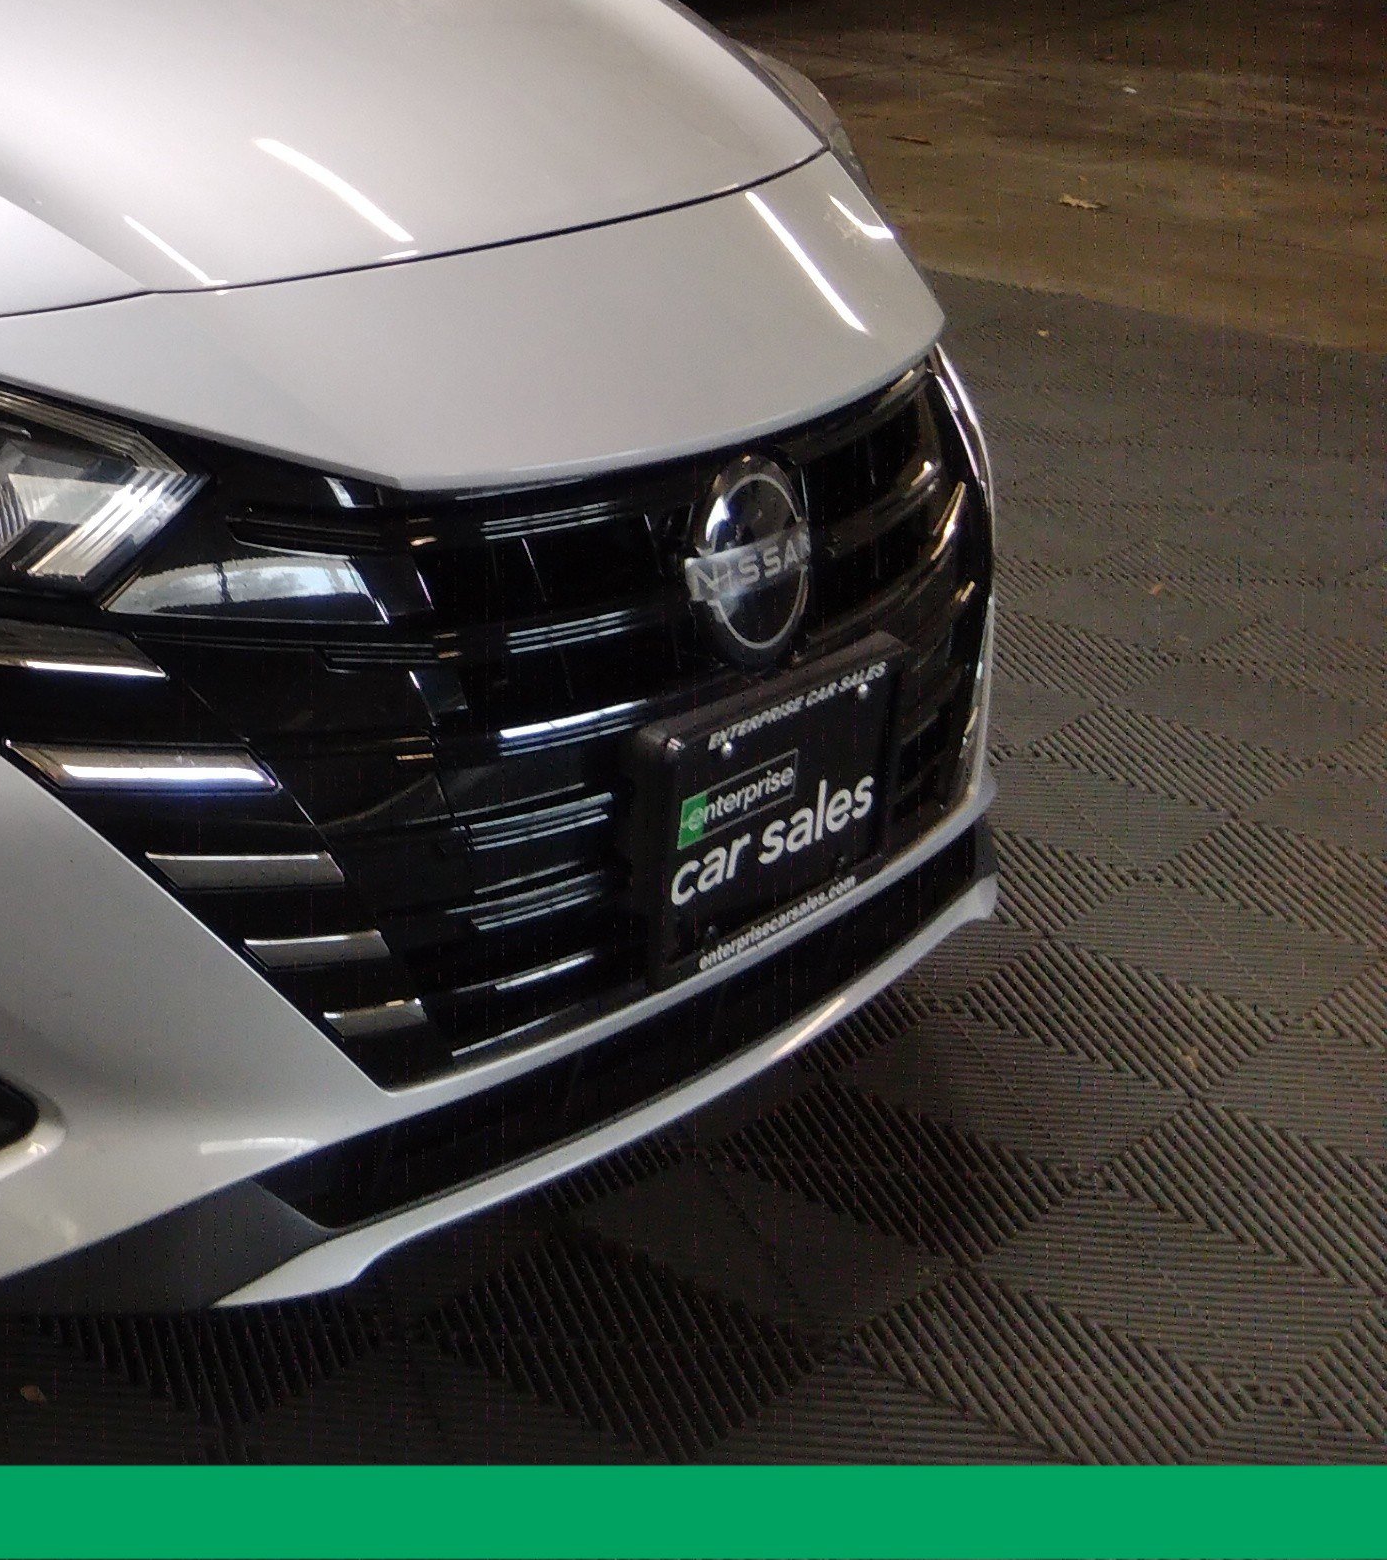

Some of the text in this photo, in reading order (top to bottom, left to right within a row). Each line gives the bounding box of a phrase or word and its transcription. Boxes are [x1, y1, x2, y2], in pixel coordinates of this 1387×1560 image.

[671, 775, 875, 906] car sales
[688, 766, 793, 832] enterprise
